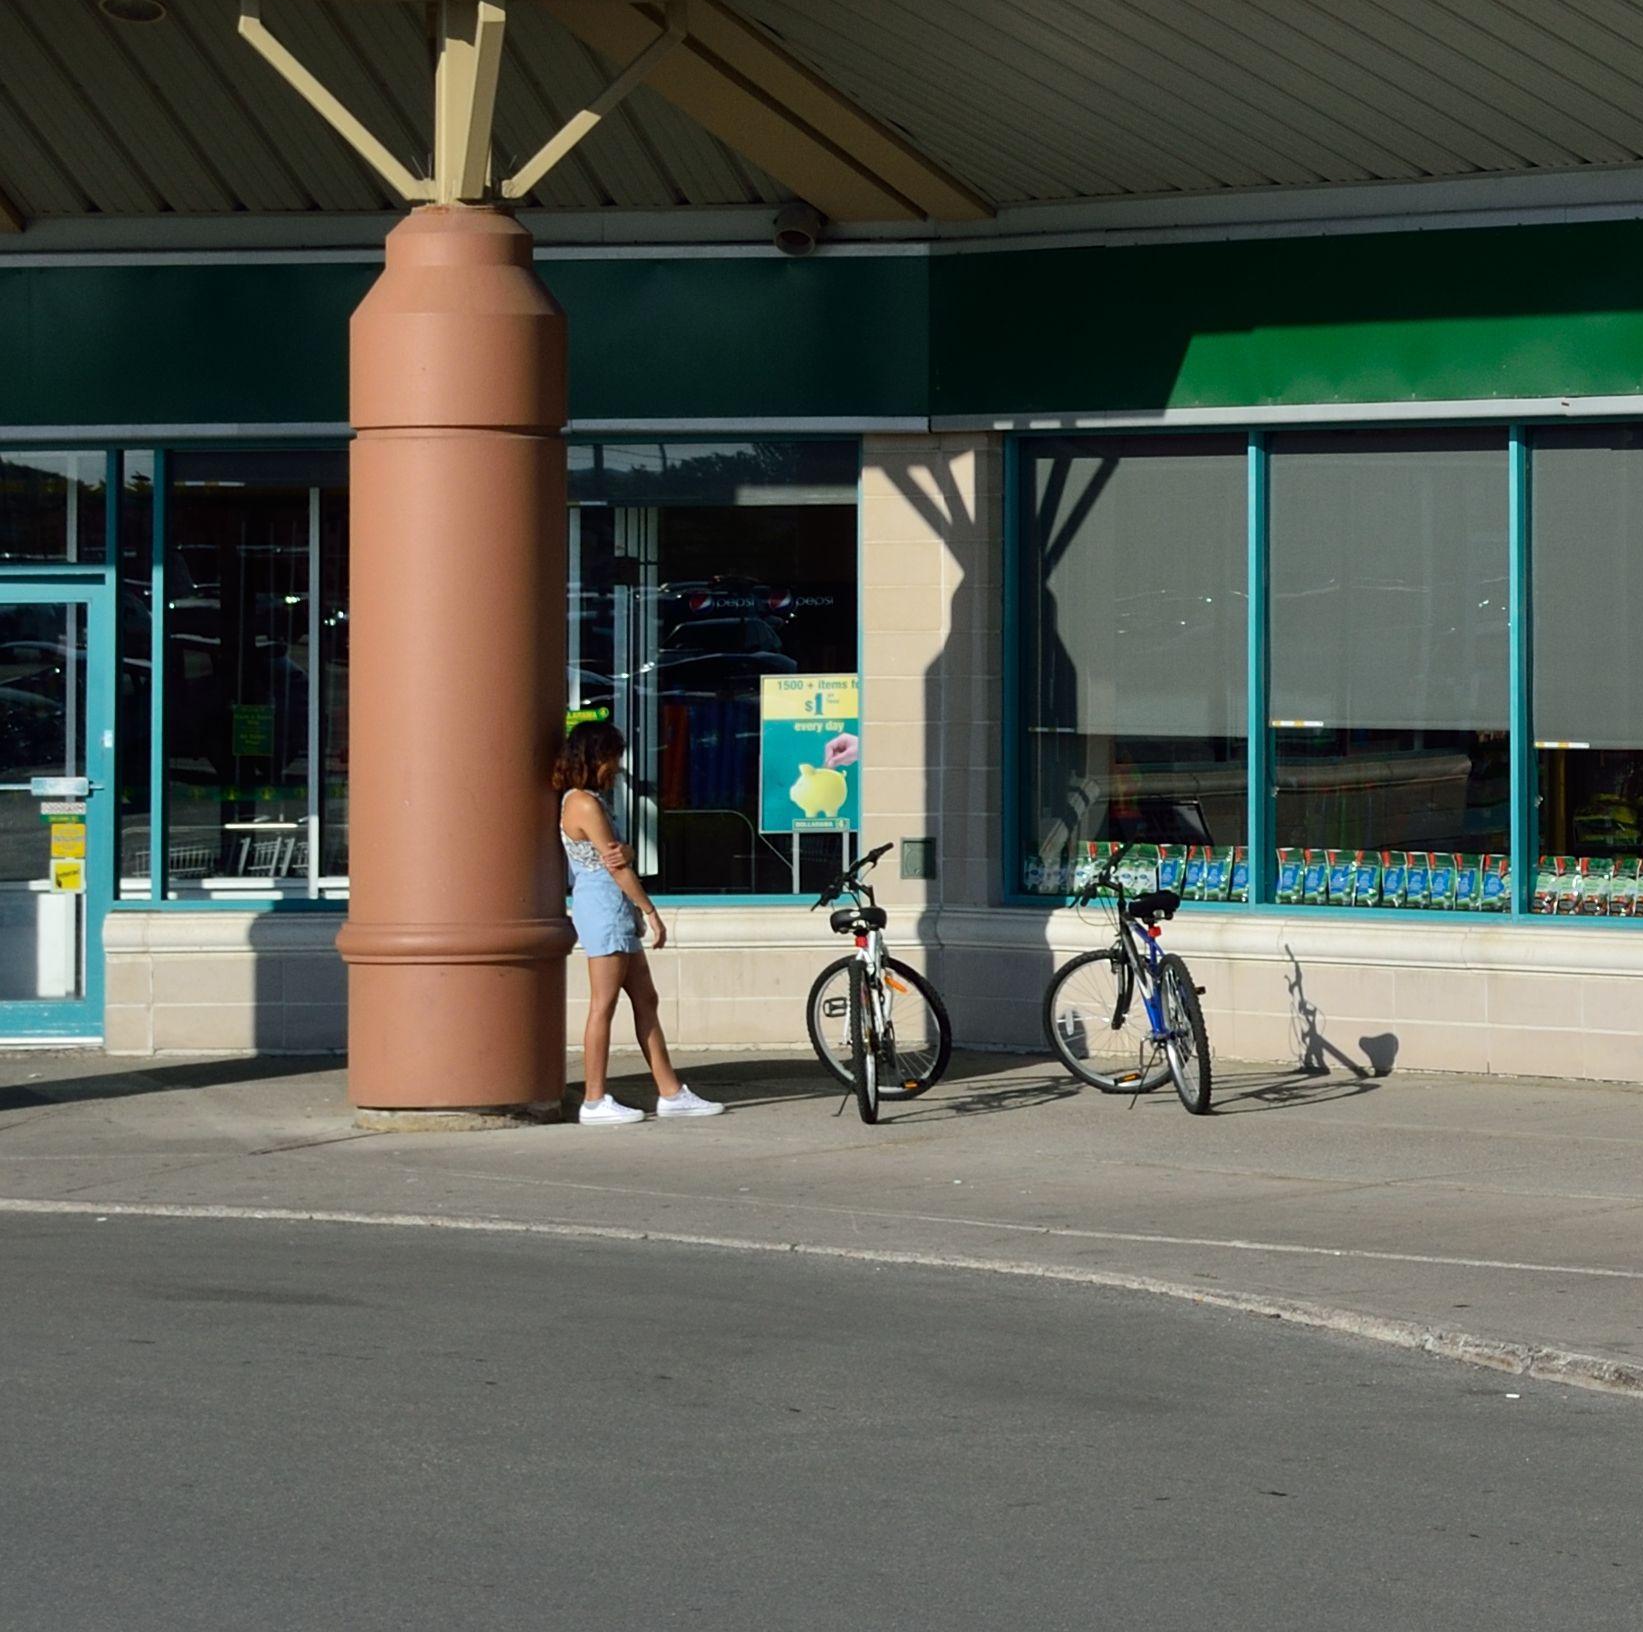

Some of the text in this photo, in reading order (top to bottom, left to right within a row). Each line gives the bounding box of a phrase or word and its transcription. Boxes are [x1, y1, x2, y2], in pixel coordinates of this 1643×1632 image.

[777, 680, 804, 691] 1500
[818, 679, 847, 689] items
[804, 692, 824, 716] $1
[794, 720, 845, 733] every day
